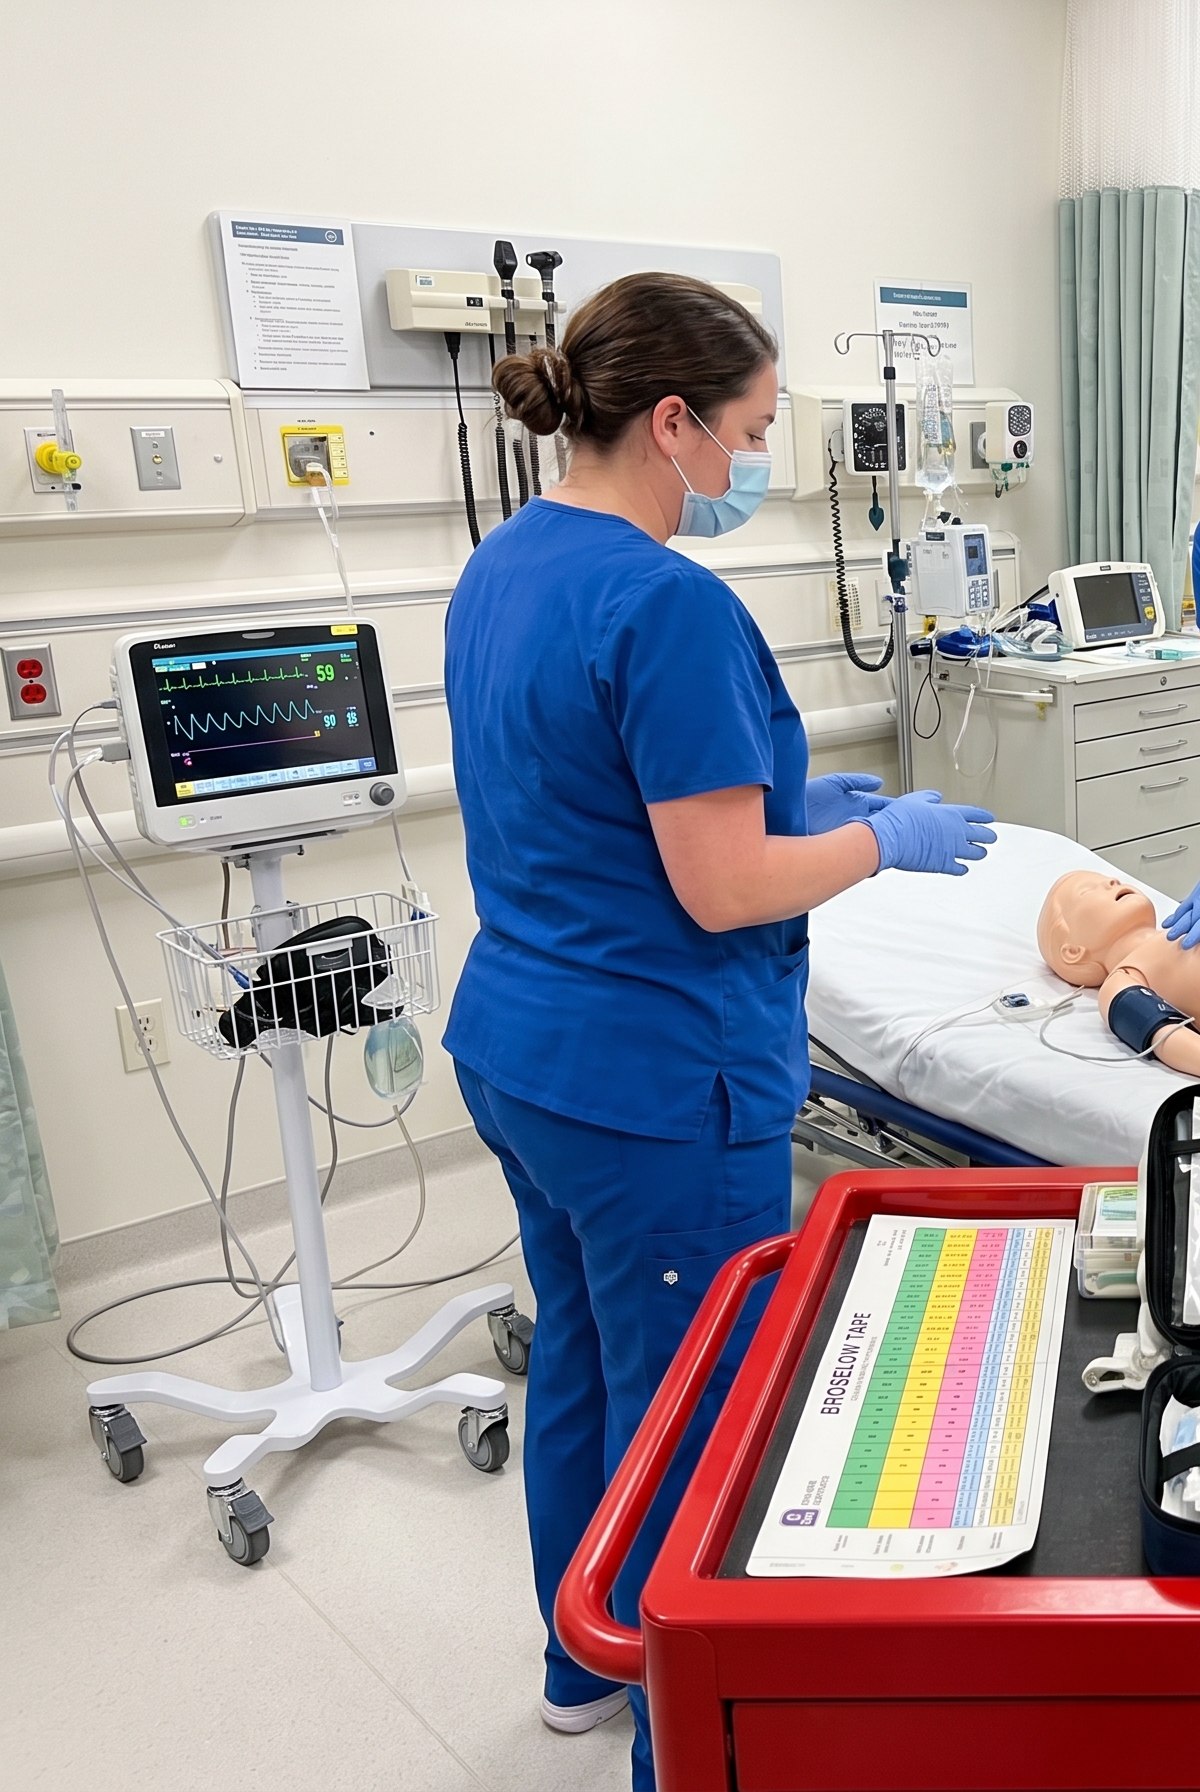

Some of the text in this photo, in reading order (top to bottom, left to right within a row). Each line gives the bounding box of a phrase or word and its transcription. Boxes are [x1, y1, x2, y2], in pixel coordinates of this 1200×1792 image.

[316, 664, 335, 682] 59
[820, 1344, 860, 1414] BROSELOW
[845, 1313, 872, 1341] TAPE
